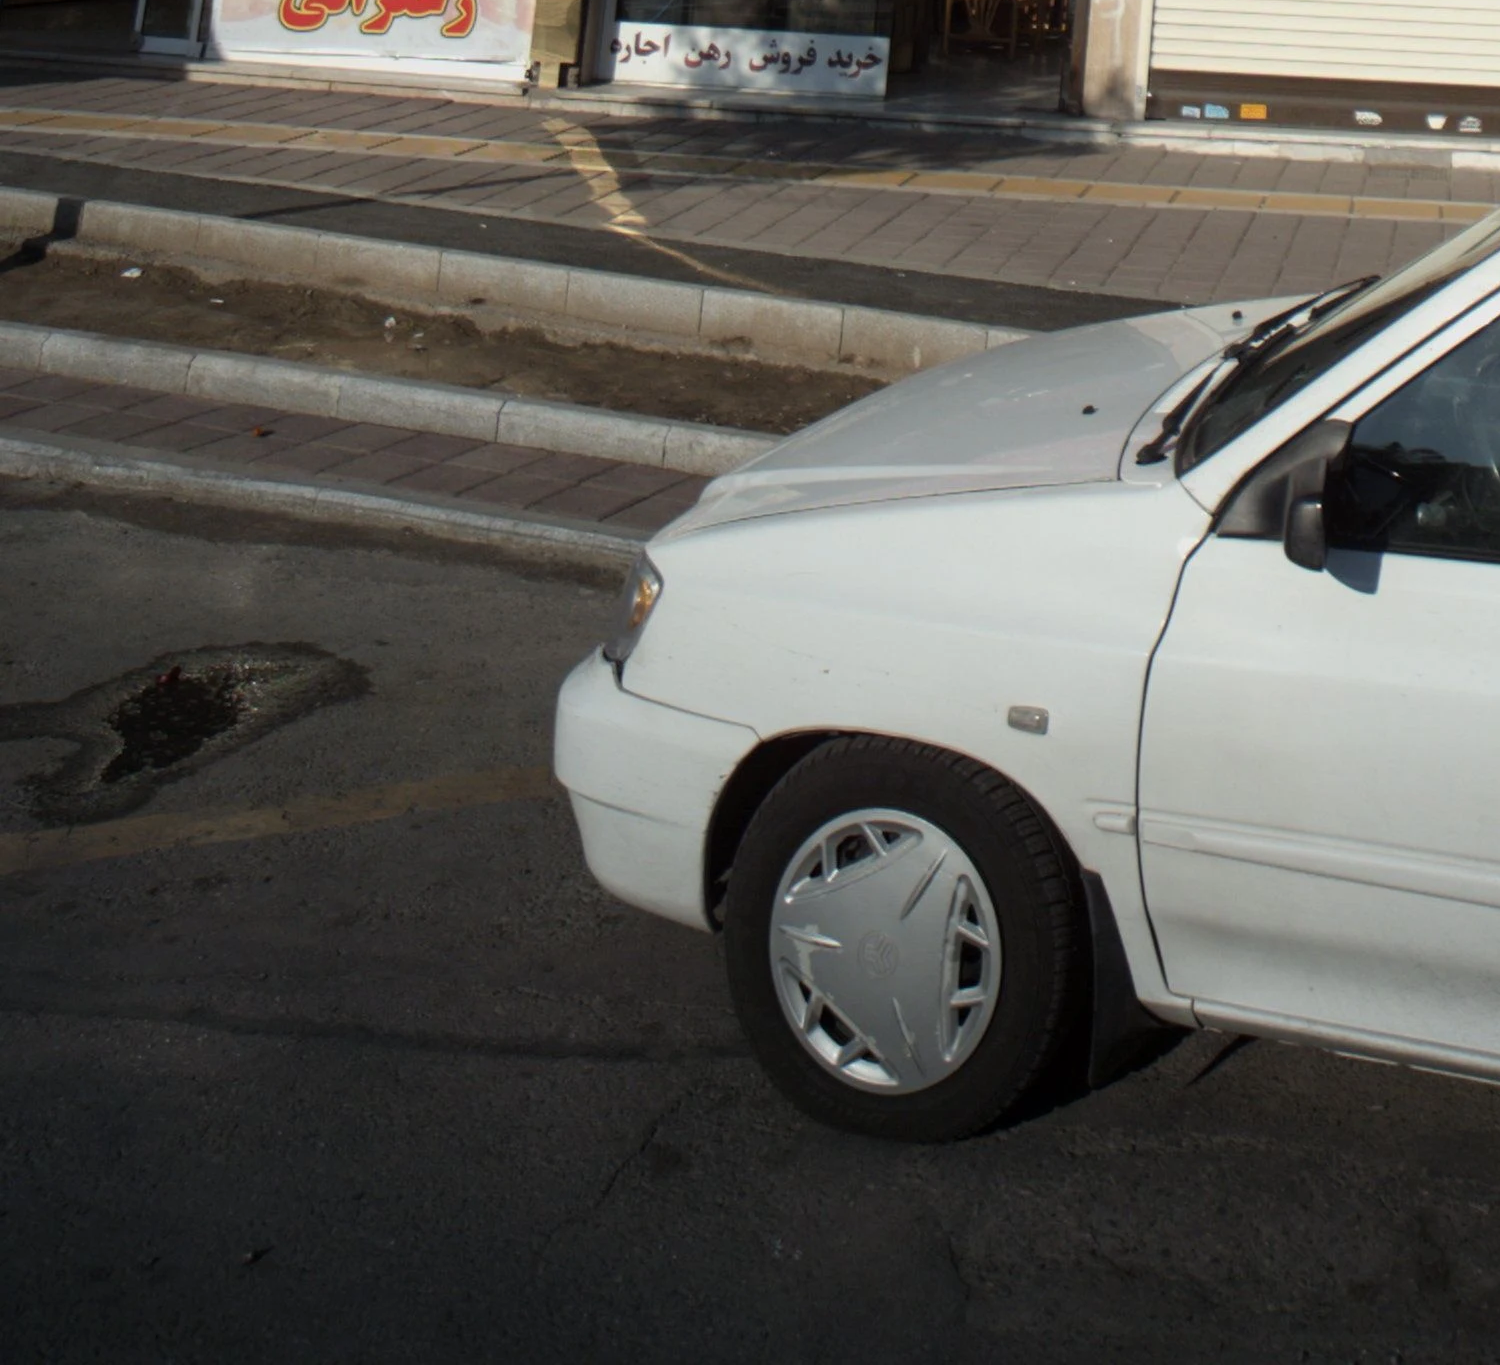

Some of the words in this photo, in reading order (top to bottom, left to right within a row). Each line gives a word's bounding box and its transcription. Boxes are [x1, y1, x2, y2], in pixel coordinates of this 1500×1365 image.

[610, 31, 672, 65] اجاره
[684, 41, 732, 70] رهن
[749, 38, 818, 75] فروش
[828, 45, 883, 79] خرید
